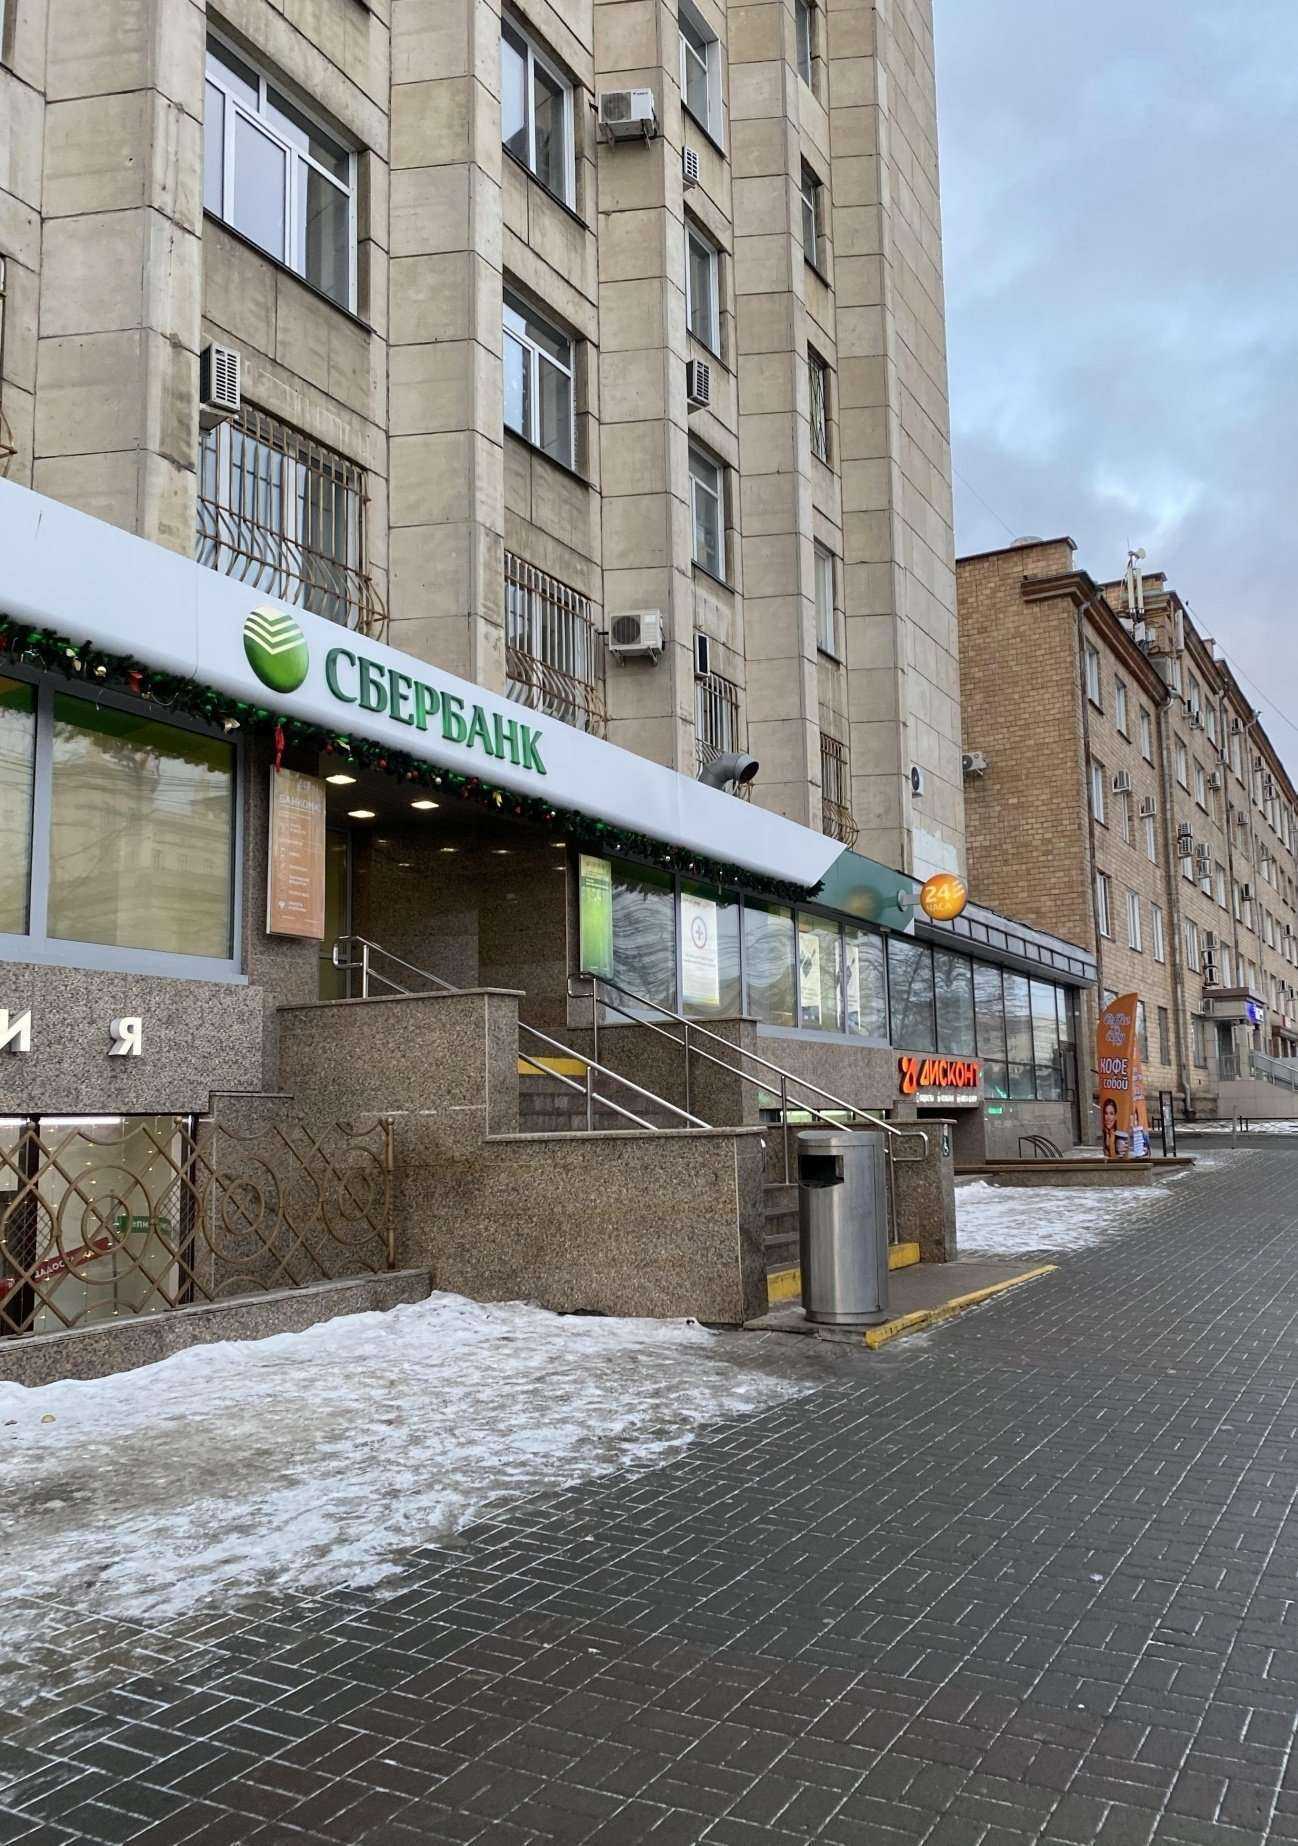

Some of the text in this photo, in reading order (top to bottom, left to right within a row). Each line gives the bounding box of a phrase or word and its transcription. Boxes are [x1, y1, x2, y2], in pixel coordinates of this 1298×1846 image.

[325, 648, 547, 775] СБЕРБАНК
[926, 884, 951, 903] 24
[1100, 1058, 1129, 1075] КОФЕ
